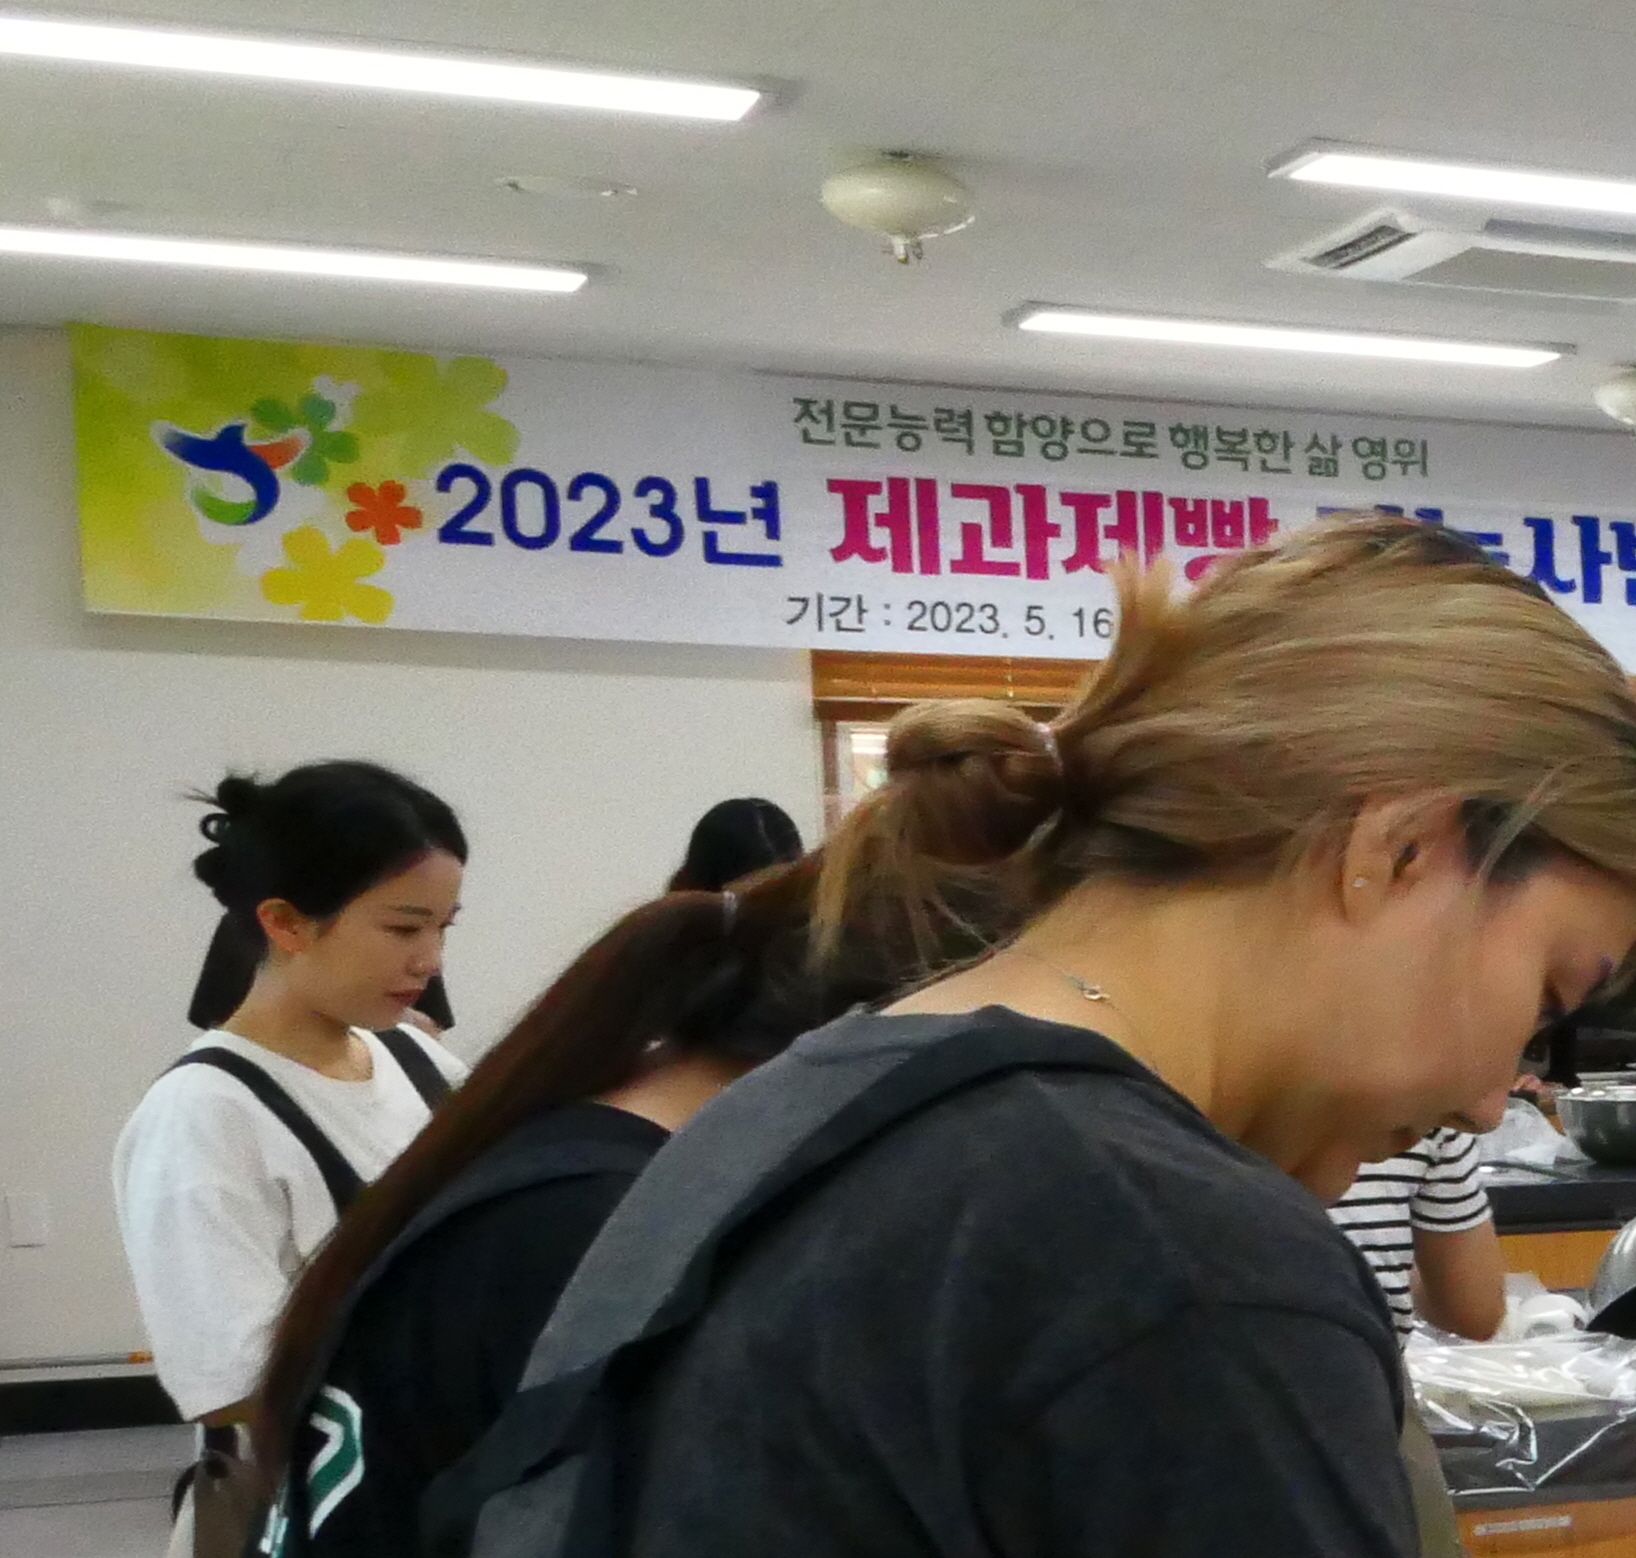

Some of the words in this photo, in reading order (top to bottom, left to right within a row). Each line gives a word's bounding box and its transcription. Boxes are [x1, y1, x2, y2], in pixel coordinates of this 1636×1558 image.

[793, 397, 975, 456] 전문능력
[984, 410, 1159, 462] 함양으로
[1168, 421, 1295, 474] 행복한
[1304, 430, 1343, 478] 삶
[1351, 435, 1429, 481] 영위
[435, 462, 784, 567] 2023년
[786, 592, 869, 633] 기간
[906, 600, 1008, 639] 2023.
